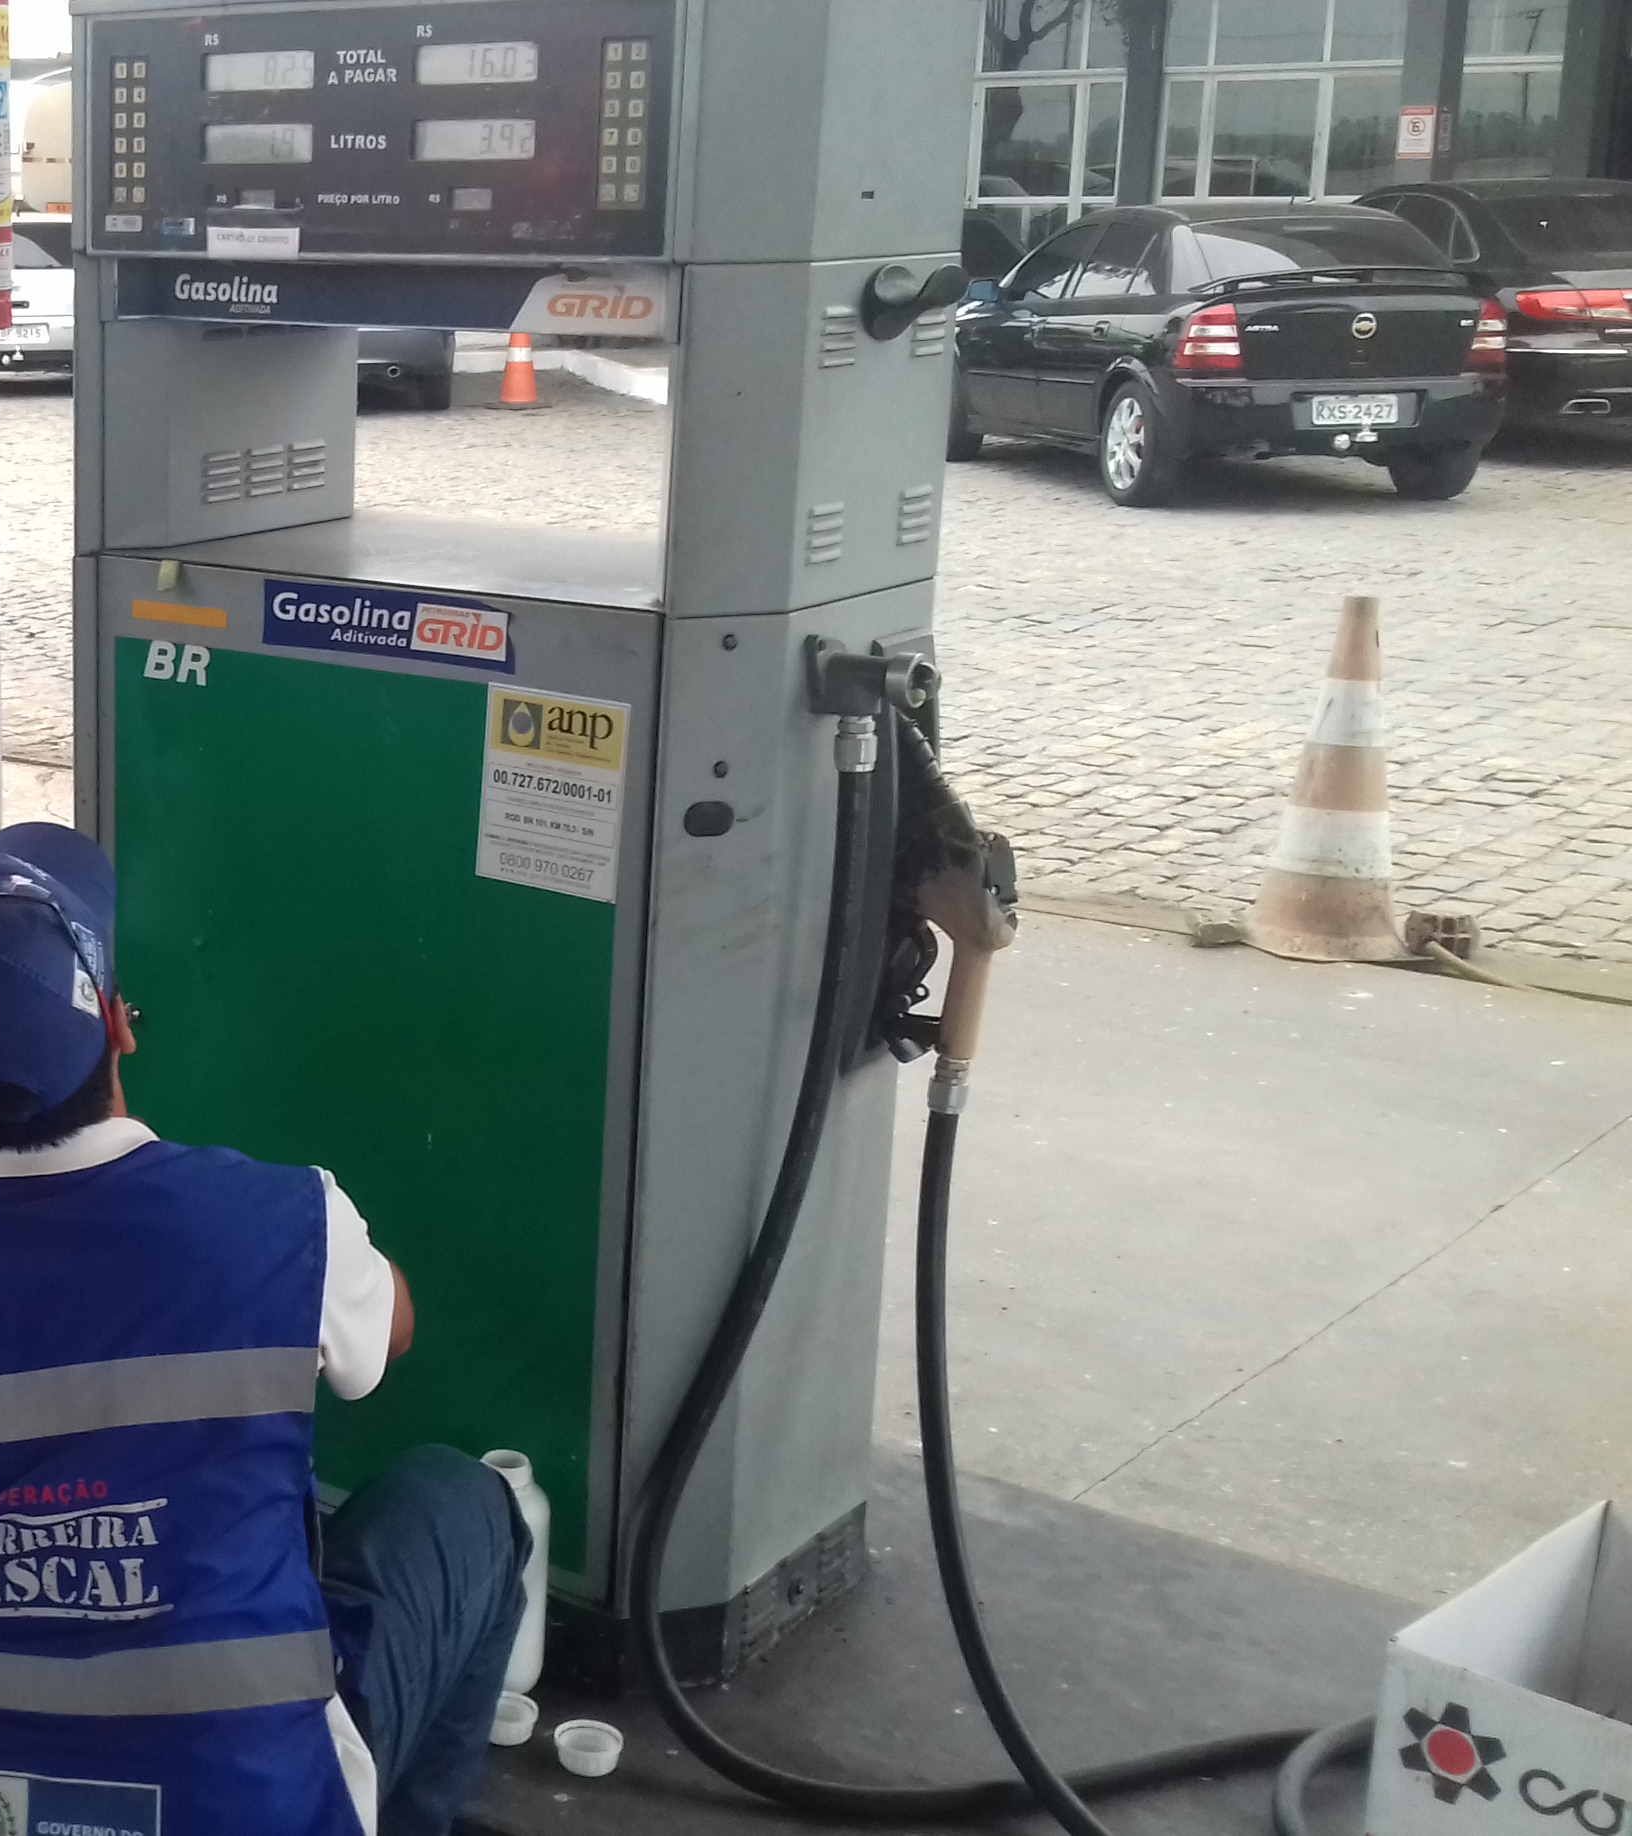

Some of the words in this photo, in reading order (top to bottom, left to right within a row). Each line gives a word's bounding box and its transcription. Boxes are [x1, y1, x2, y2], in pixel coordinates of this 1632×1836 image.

[204, 33, 219, 46] R$
[416, 24, 433, 38] R$
[335, 49, 386, 65] TOTAL
[326, 71, 339, 86] A
[344, 68, 398, 84] PAGAR
[329, 134, 387, 150] LITROS
[317, 193, 348, 206] PREÇO
[350, 194, 369, 205] POR
[371, 194, 400, 205] LITRO
[174, 272, 279, 304] Gasolina
[547, 284, 654, 320] GRID
[1316, 402, 1394, 420] KXS-2427
[272, 591, 412, 633] Gasolina
[329, 627, 408, 649] Aditivada
[416, 611, 505, 652] GRID
[143, 639, 211, 688] BR
[546, 705, 614, 751] anp
[492, 768, 613, 805] 00.727.672/0001-01
[499, 851, 531, 870] 0800
[534, 858, 558, 876] 970
[561, 864, 595, 883] 0267
